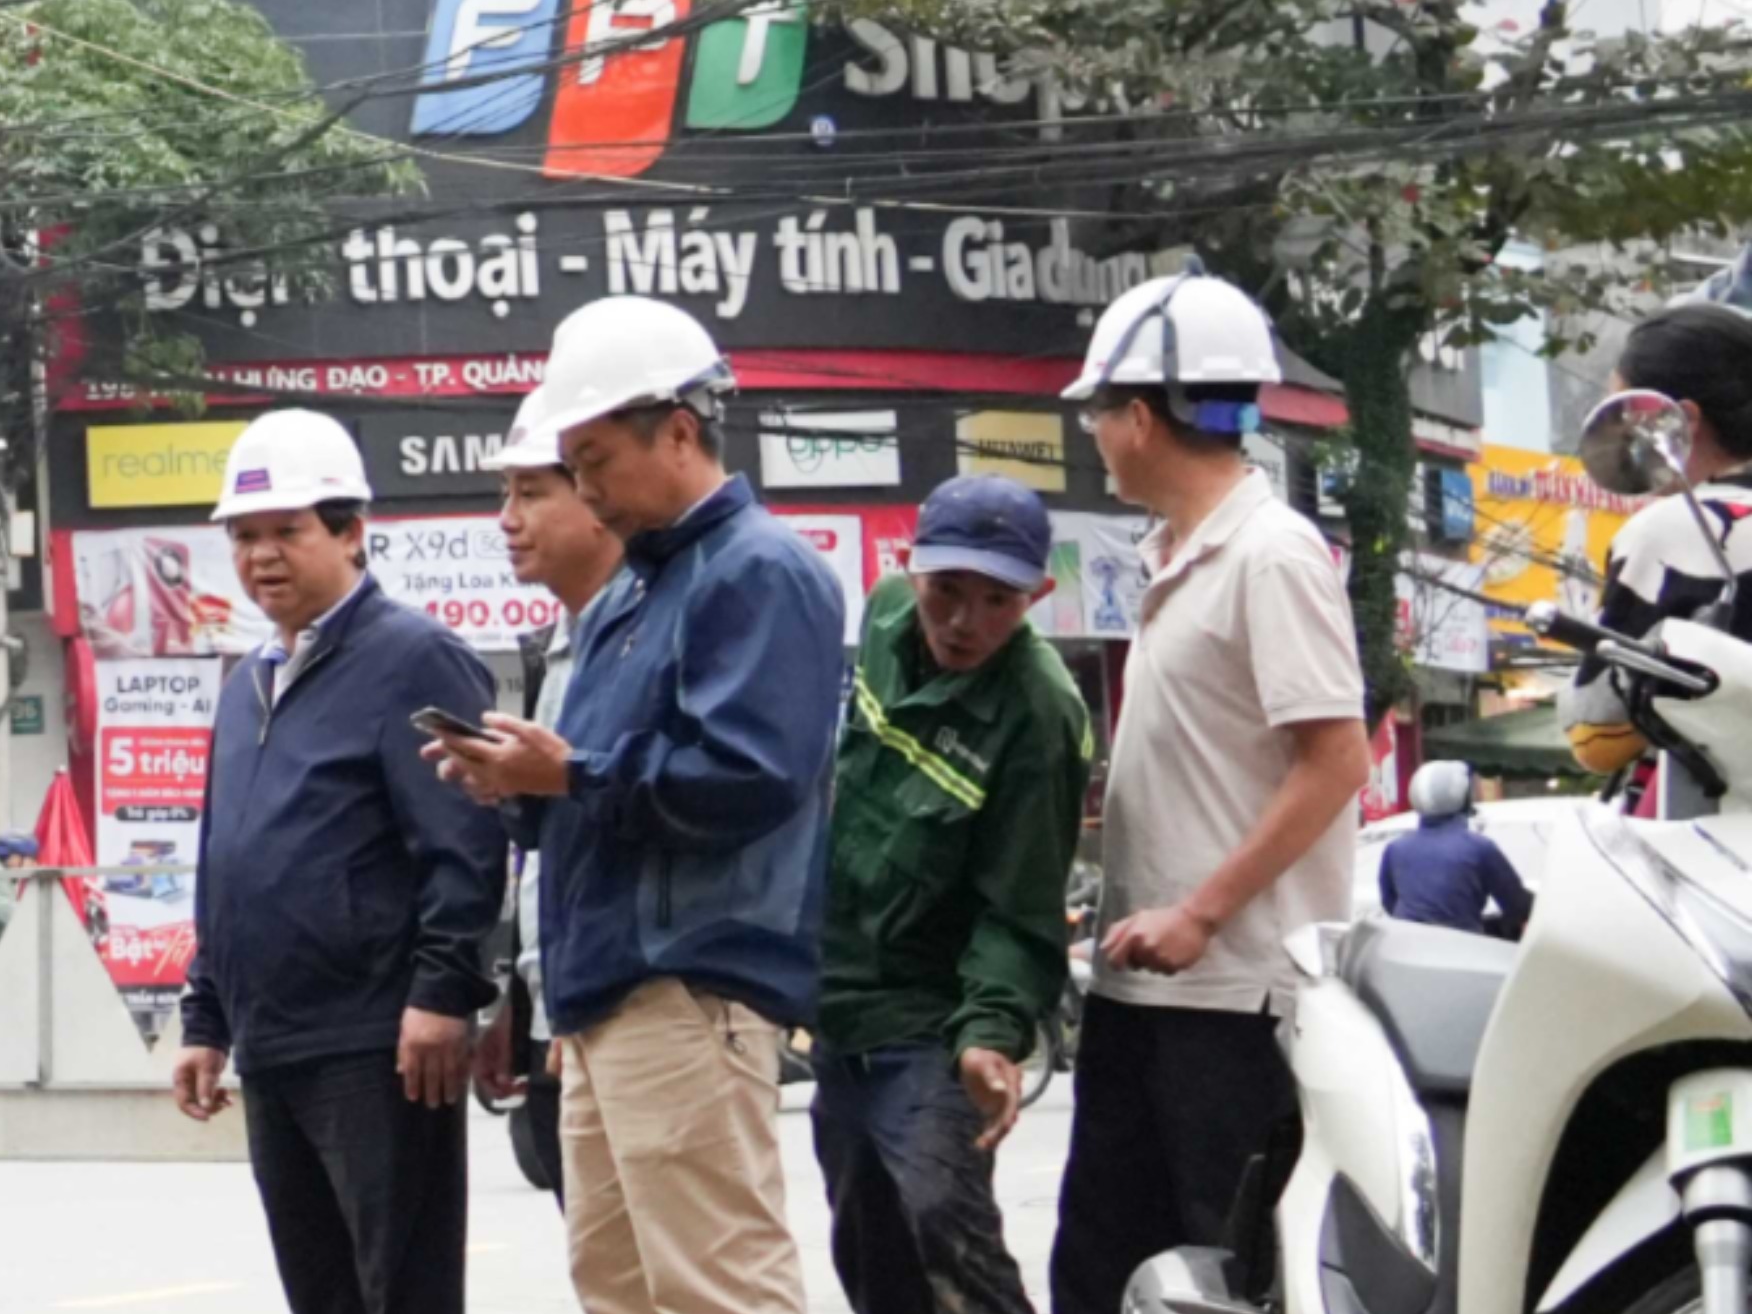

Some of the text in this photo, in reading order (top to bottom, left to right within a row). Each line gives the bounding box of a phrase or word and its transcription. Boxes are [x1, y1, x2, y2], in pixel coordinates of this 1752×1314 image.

[344, 212, 540, 317] thoại
[604, 206, 757, 319] Máy
[774, 207, 900, 294] tính
[943, 216, 1036, 302] Gia
[326, 364, 389, 395] ĐẠO
[414, 362, 456, 388] TP.
[462, 354, 545, 387] QUẢN
[404, 529, 469, 561] X9d
[116, 675, 201, 695] LAPTOP
[109, 737, 134, 776] 5
